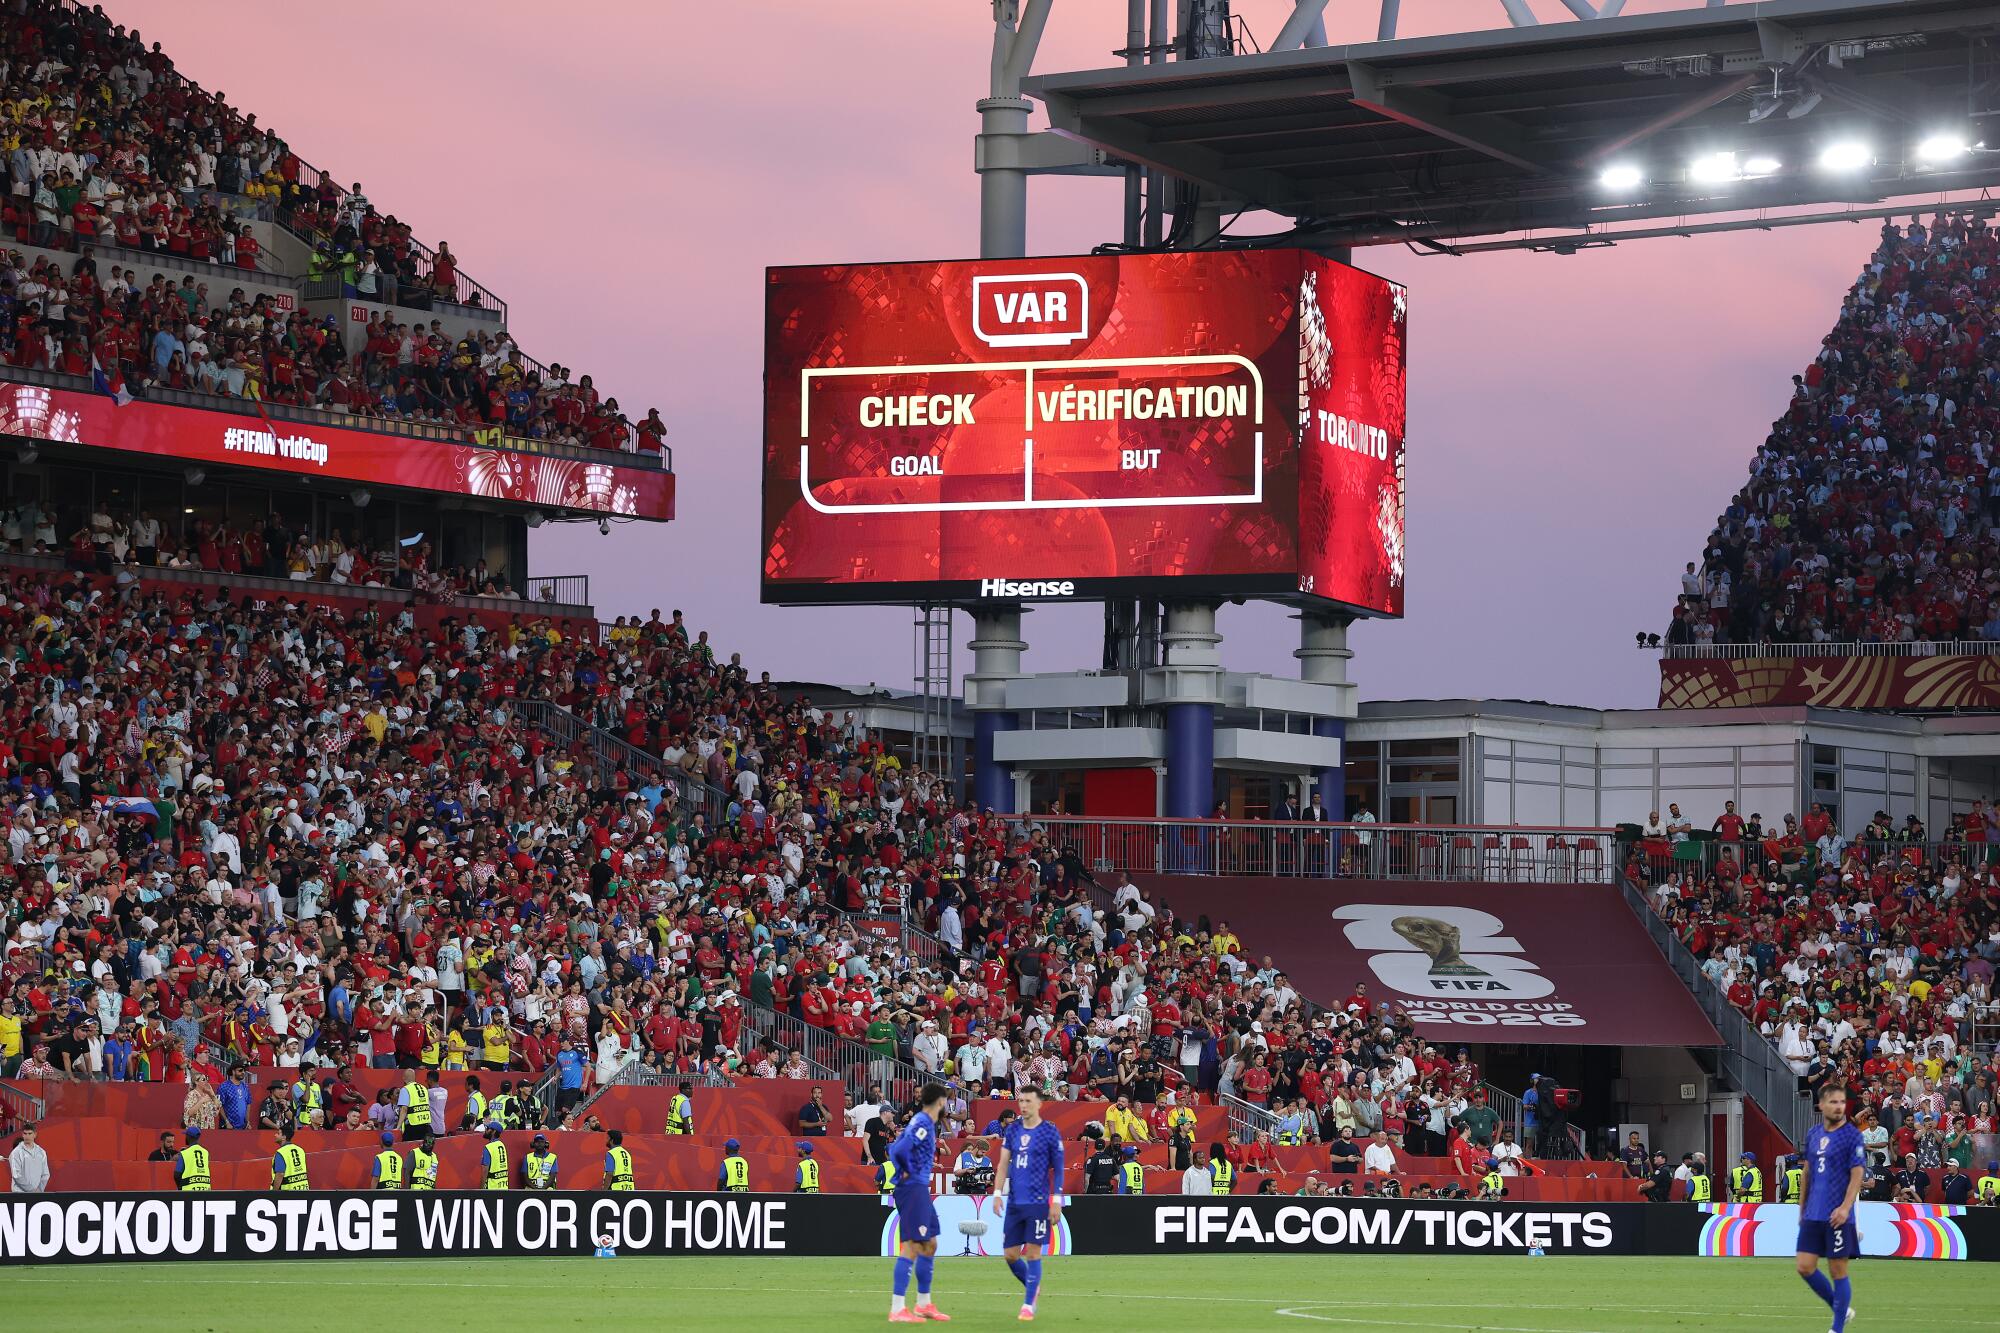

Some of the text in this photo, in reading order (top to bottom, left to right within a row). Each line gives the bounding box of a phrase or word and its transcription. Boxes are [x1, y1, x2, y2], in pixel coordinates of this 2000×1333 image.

[277, 296, 292, 309] 210
[994, 291, 1068, 324] VAR
[353, 308, 366, 321] 211
[859, 393, 976, 428] CHECK
[1037, 384, 1248, 422] VÉRIFICATION
[1318, 409, 1388, 461] TORONTO
[890, 455, 944, 477] GOAL
[1122, 448, 1161, 470] BUT
[980, 578, 1076, 597] Hisense
[871, 927, 887, 936] FIFA
[992, 967, 1001, 981] 7
[1430, 979, 1513, 991] FIFA
[1397, 999, 1574, 1012] WORLD CUP
[1406, 1010, 1588, 1027] 2026
[1016, 1154, 1028, 1169] 14
[1817, 1157, 1826, 1174] 3
[245, 1198, 397, 1253] STAGE
[415, 1199, 503, 1250] WIN
[516, 1198, 578, 1250] OR
[590, 1198, 653, 1250] GO
[665, 1200, 786, 1250] HOME
[1035, 1219, 1048, 1233] 14
[1155, 1205, 1613, 1248] FIFA.COM/TICKETS
[1833, 1230, 1844, 1247] 3
